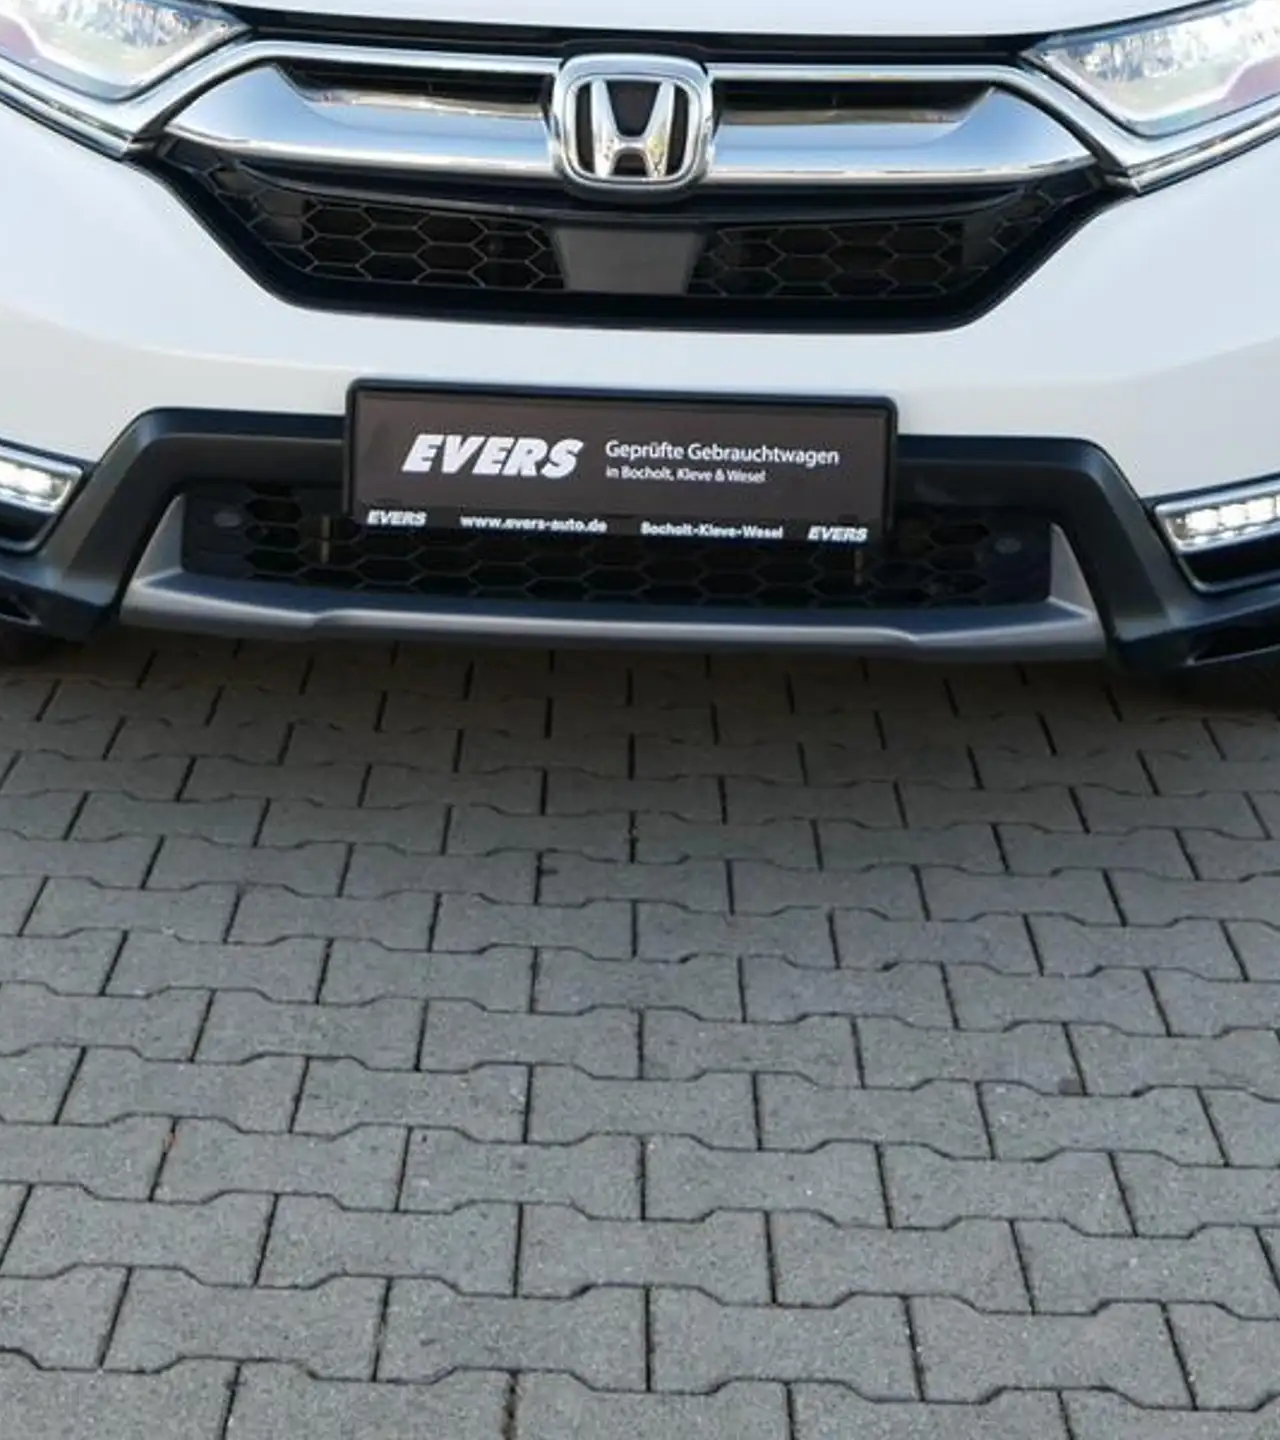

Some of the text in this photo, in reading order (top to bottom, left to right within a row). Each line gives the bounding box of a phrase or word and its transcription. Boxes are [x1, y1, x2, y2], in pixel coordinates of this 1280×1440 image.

[401, 433, 585, 479] EVERS
[605, 439, 840, 469] Geprüfte Gebrauchtwagen
[605, 464, 767, 483] in Bocholt, Kleve & Wesel
[367, 510, 428, 526] EVERS
[460, 515, 608, 533] www.evers-auto.de
[640, 521, 785, 539] Bocholt-Kleve-Wesel
[806, 525, 869, 542] EVERS
